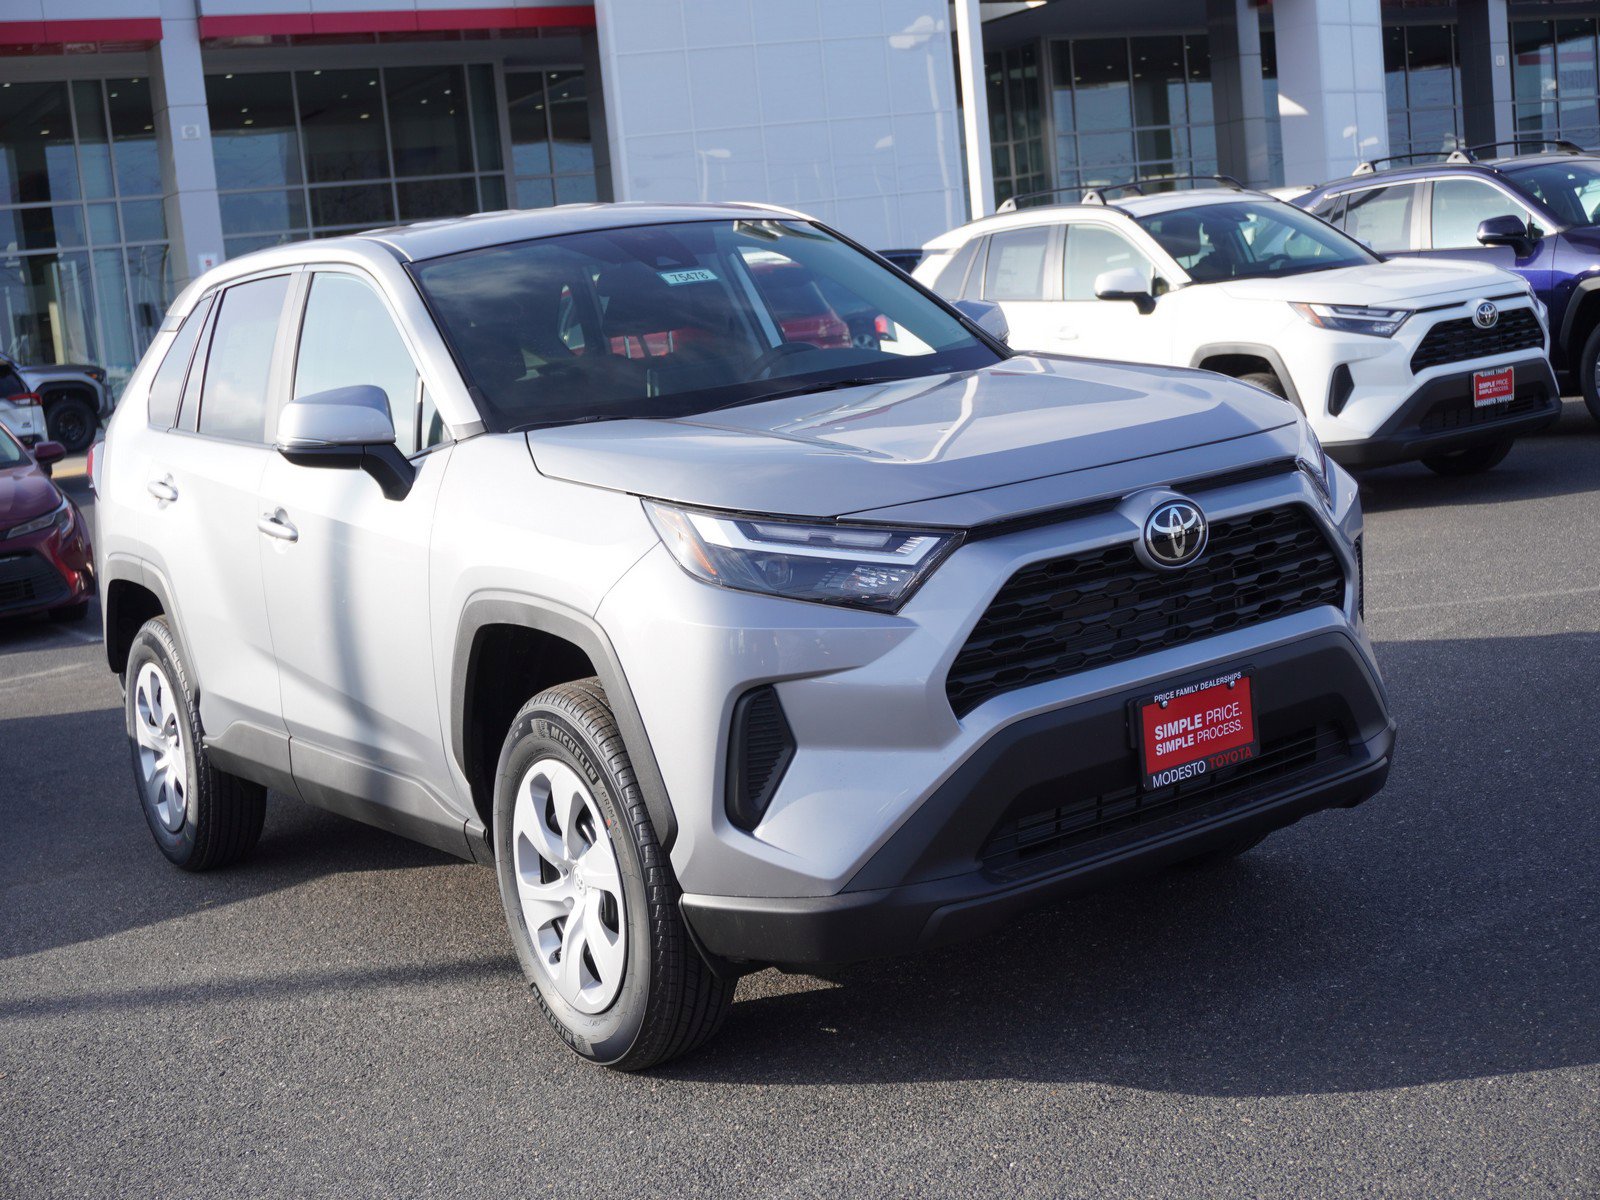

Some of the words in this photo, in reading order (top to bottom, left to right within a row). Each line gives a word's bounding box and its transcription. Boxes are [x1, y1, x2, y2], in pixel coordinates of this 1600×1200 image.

[670, 271, 709, 282] 75478
[1479, 381, 1496, 389] SIMPLE
[1154, 691, 1174, 703] PRICE
[1176, 684, 1199, 697] FAMILY
[1200, 672, 1242, 691] DEALERSHIPS
[1154, 713, 1203, 740] SIMPLE
[1206, 702, 1243, 725] PRICE.
[1156, 734, 1195, 756] SIMPLE
[1197, 719, 1244, 743] PROCESS.
[551, 726, 598, 782] MICHELIN
[1152, 760, 1206, 788] MODESTO
[1209, 746, 1252, 769] TOYOTA
